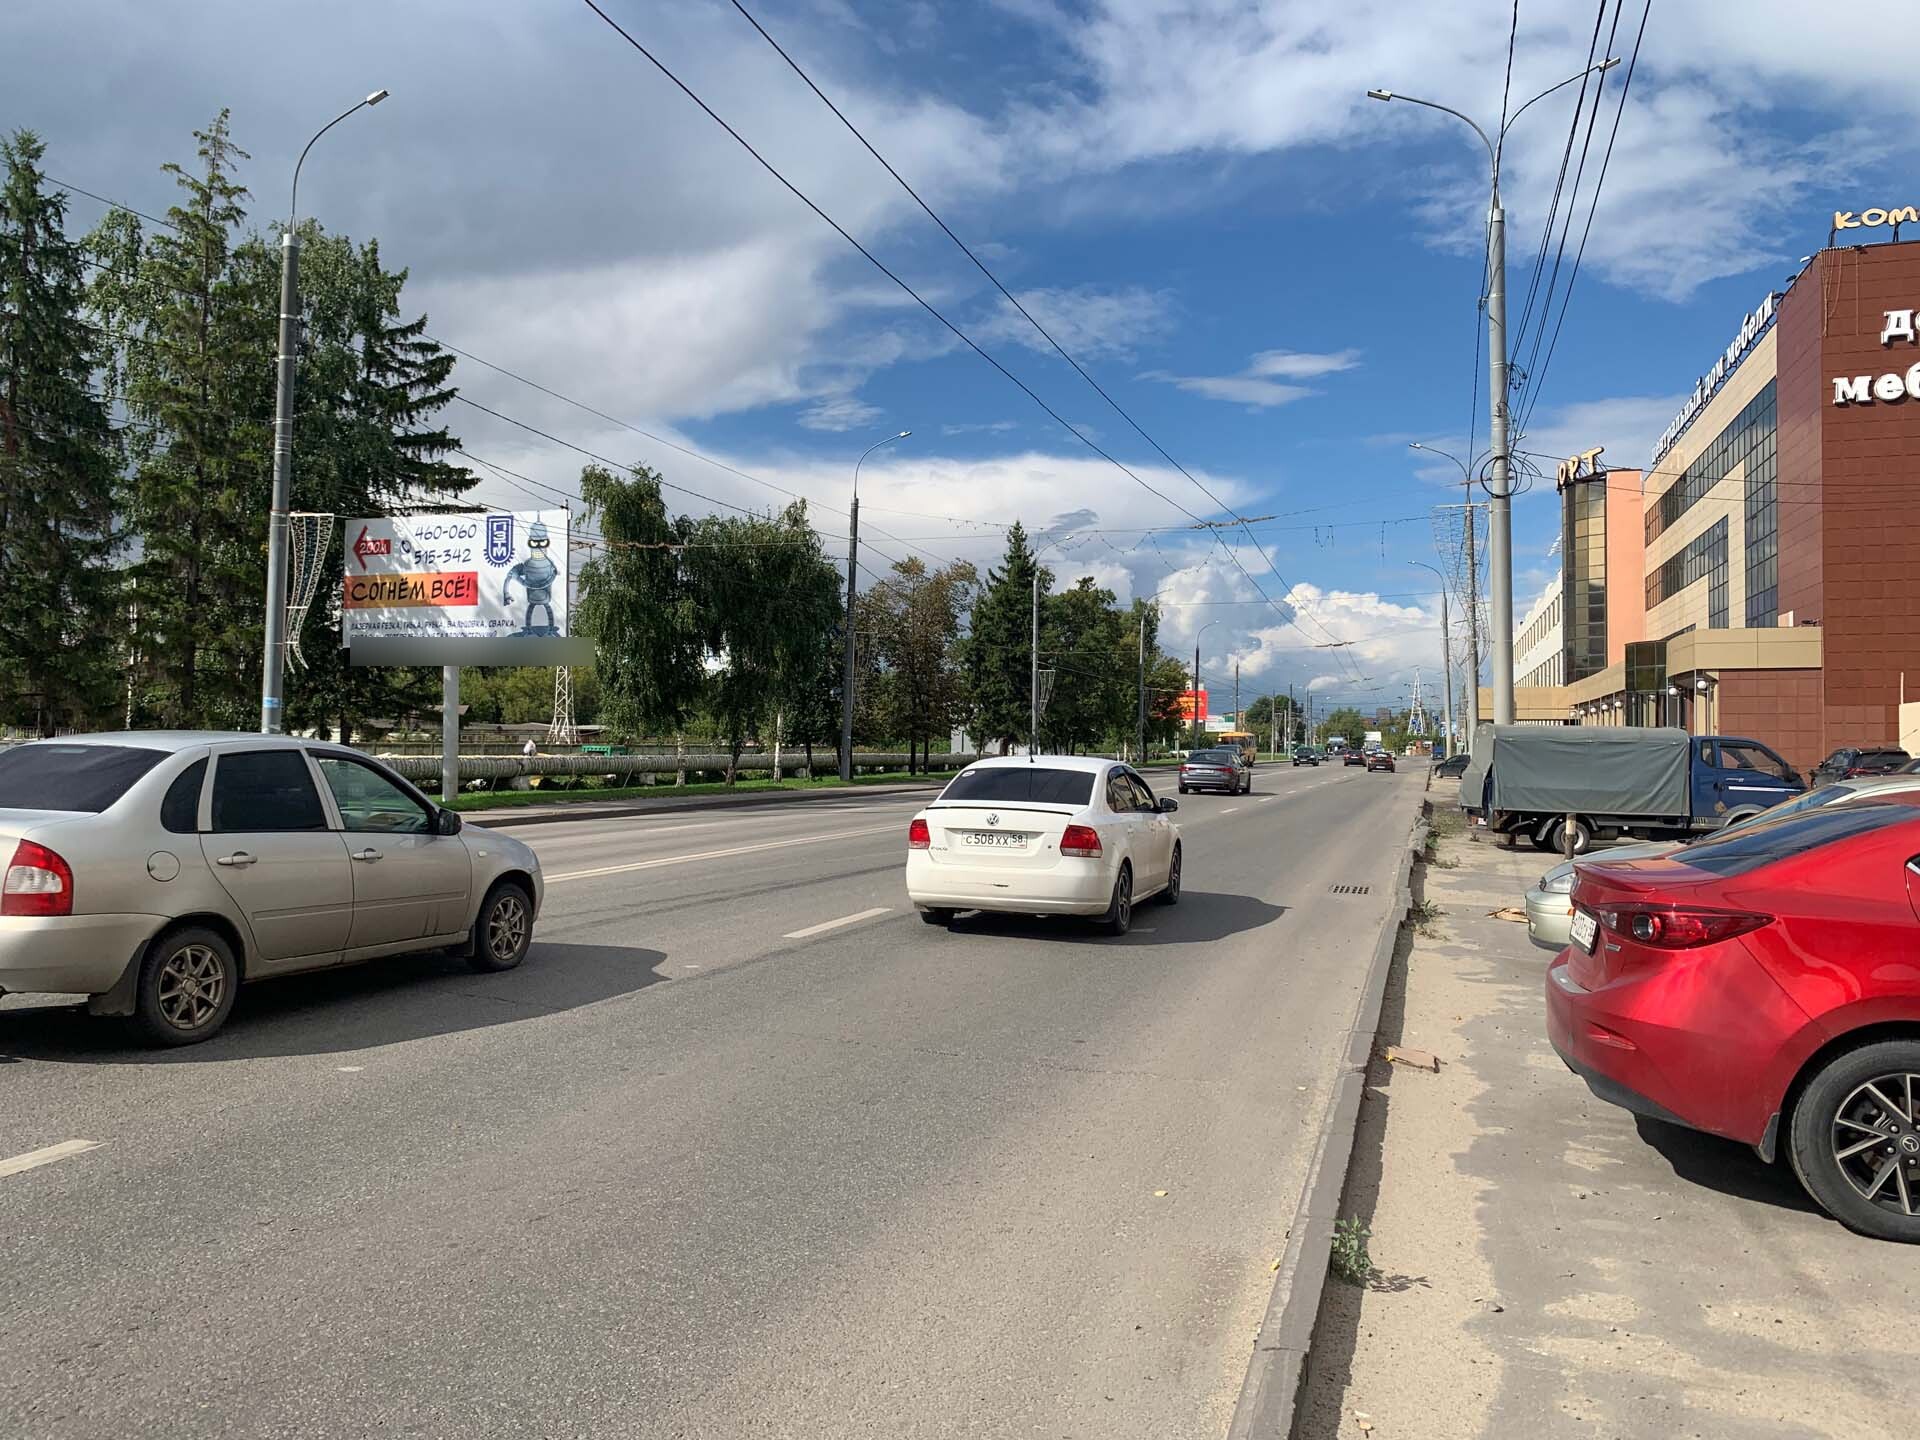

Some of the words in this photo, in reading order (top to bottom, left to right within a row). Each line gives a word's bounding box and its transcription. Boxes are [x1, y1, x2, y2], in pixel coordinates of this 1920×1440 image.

[1881, 309, 1920, 346] д
[1703, 355, 1724, 402] дом
[1726, 290, 1775, 368] мебели
[415, 523, 477, 541] 460-060
[413, 548, 472, 565] 515-342
[351, 577, 425, 600] СОГНЁМ
[431, 574, 471, 599] ВСЁ!
